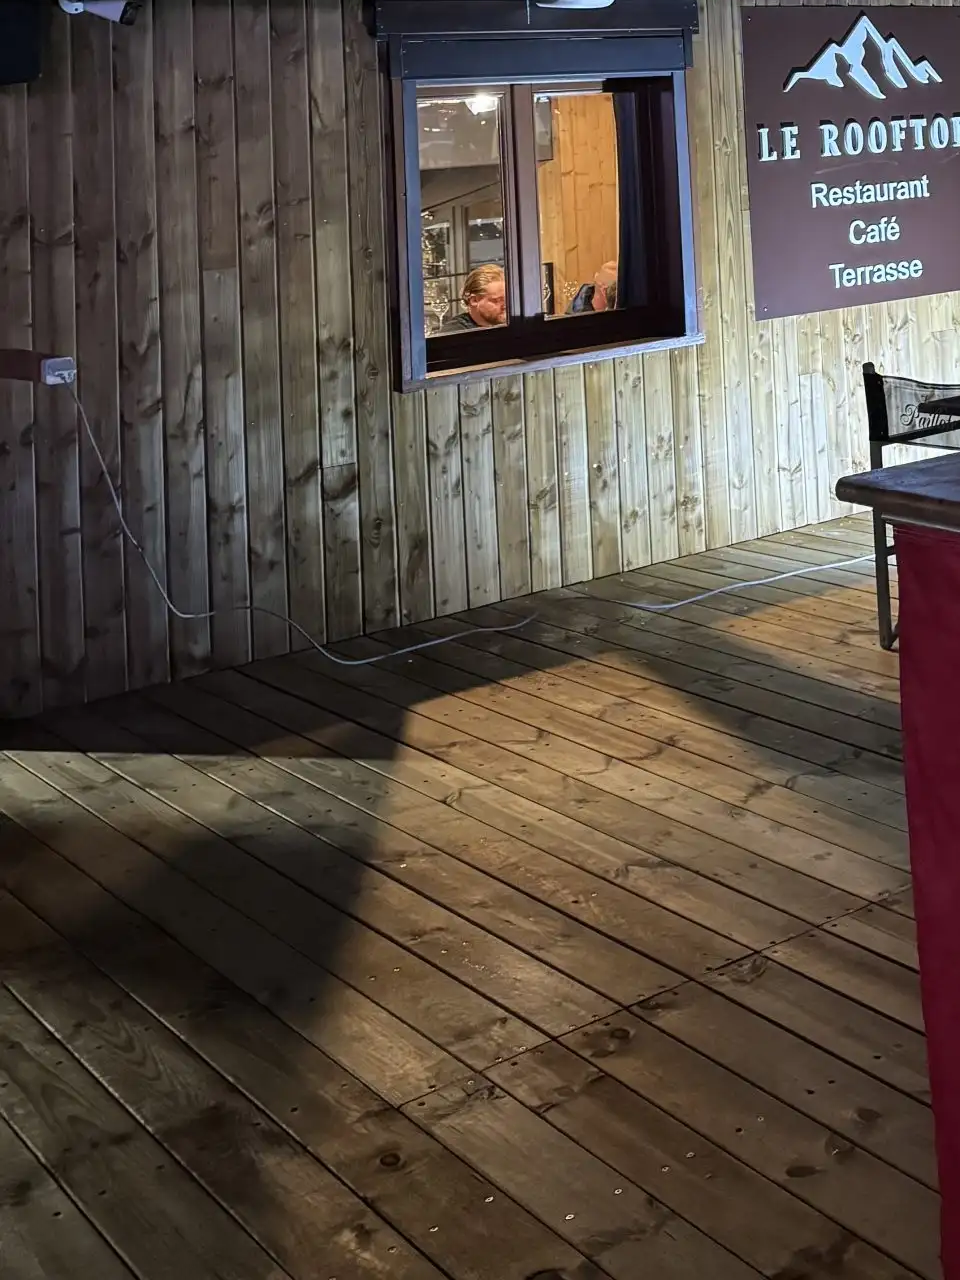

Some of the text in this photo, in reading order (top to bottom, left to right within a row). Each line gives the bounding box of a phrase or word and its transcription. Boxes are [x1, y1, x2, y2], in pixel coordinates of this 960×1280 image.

[756, 124, 801, 162] LE
[811, 174, 930, 208] Restaurant
[849, 216, 900, 245] Café
[829, 258, 923, 288] Terrasse
